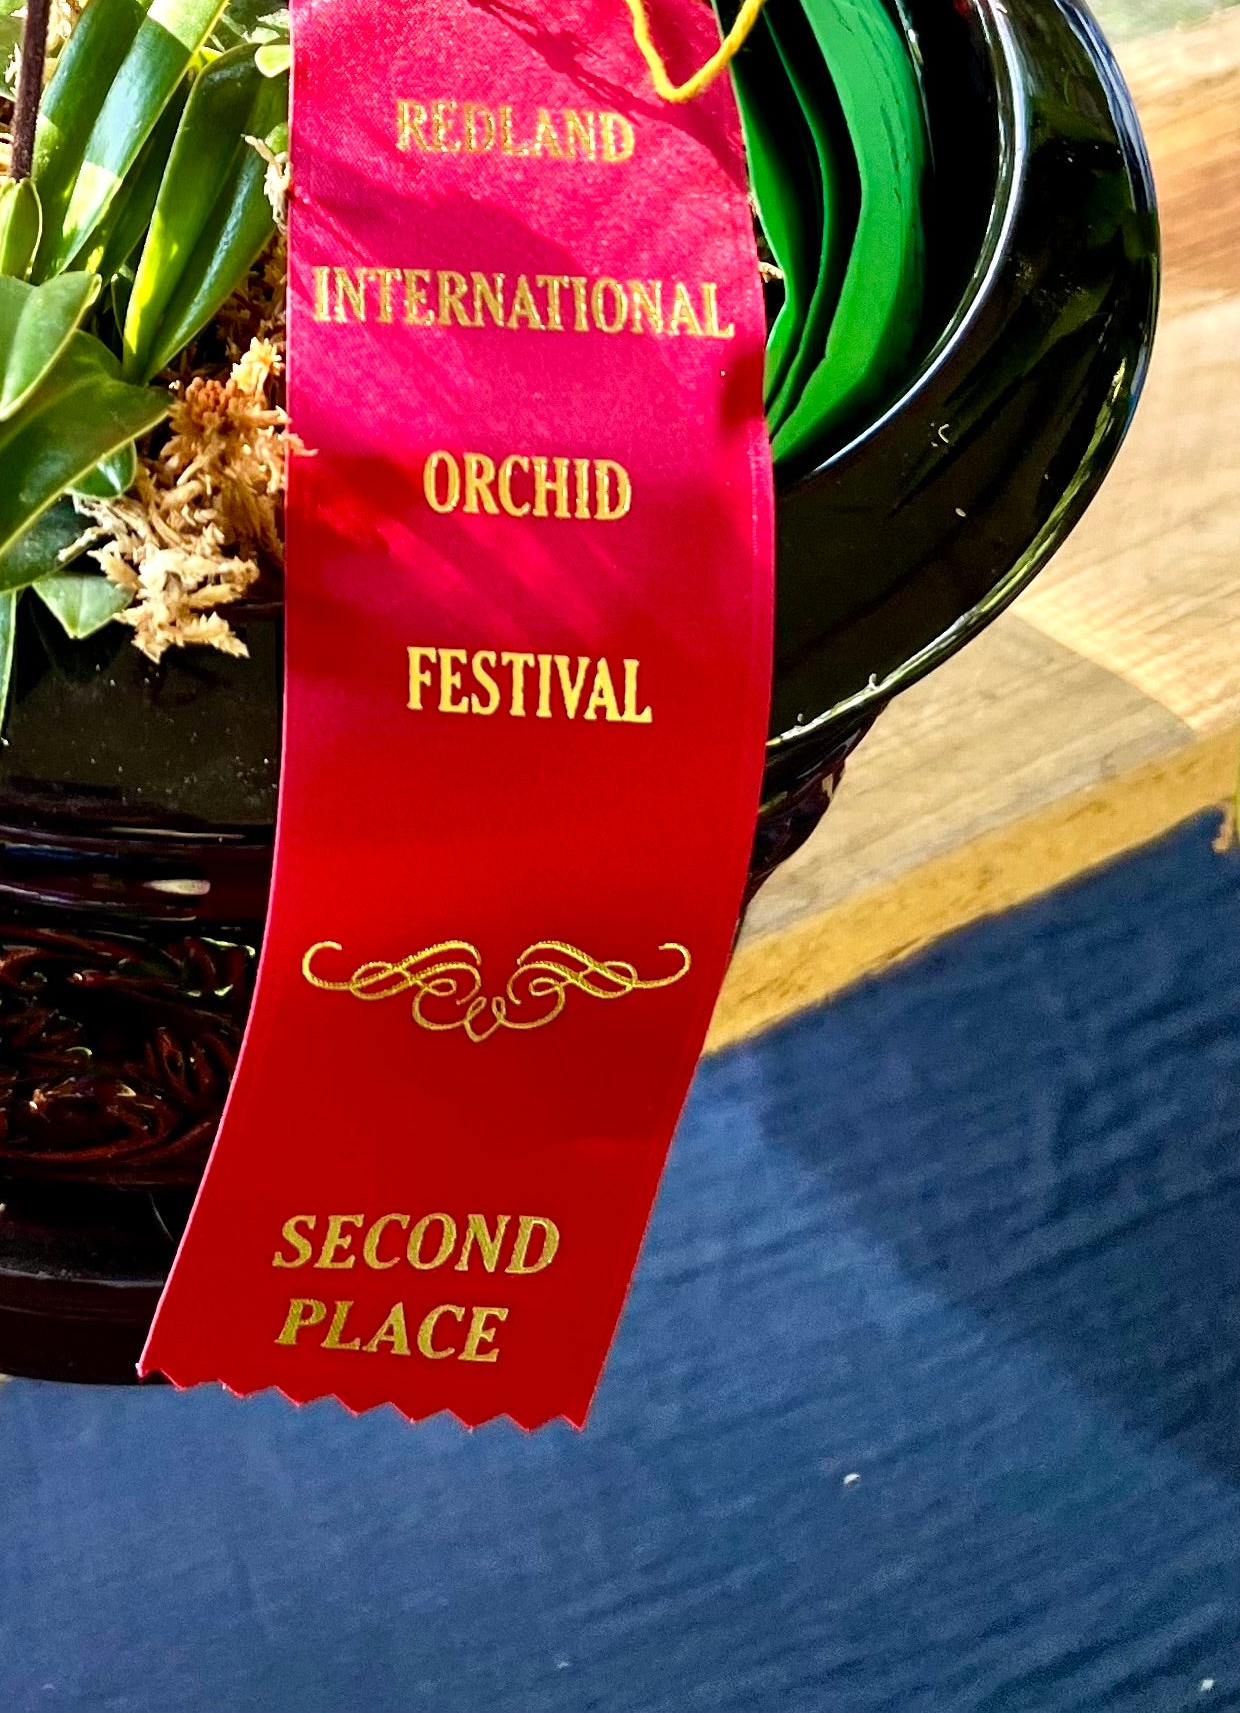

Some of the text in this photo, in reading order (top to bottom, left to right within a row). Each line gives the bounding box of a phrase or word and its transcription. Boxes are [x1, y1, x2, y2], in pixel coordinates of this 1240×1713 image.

[395, 99, 636, 164] REDLAND
[312, 266, 734, 339] INTERNATIONAL
[424, 450, 632, 520] ORCHID
[407, 646, 653, 724] FESTIVAL
[273, 1213, 560, 1275] SECOND
[275, 1299, 509, 1362] PLACE
